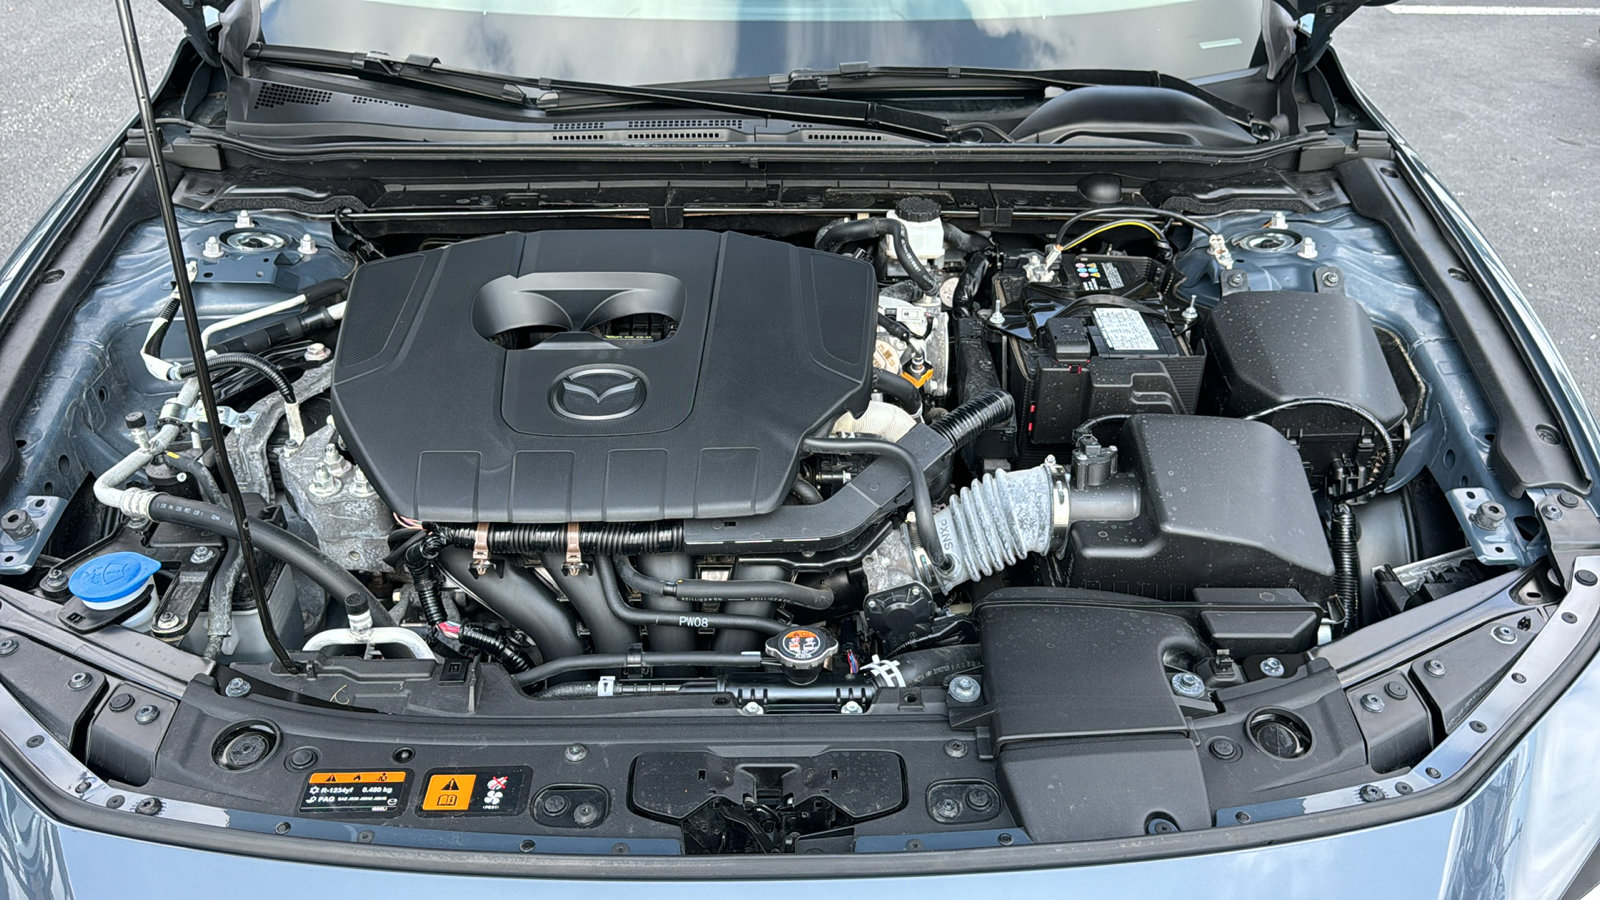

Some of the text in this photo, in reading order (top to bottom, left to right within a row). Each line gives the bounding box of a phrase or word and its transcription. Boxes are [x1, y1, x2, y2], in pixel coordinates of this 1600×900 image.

[937, 518, 954, 551] PXNS
[679, 615, 709, 628] PW08
[320, 786, 354, 794] R-1234yf
[382, 786, 393, 794] kg
